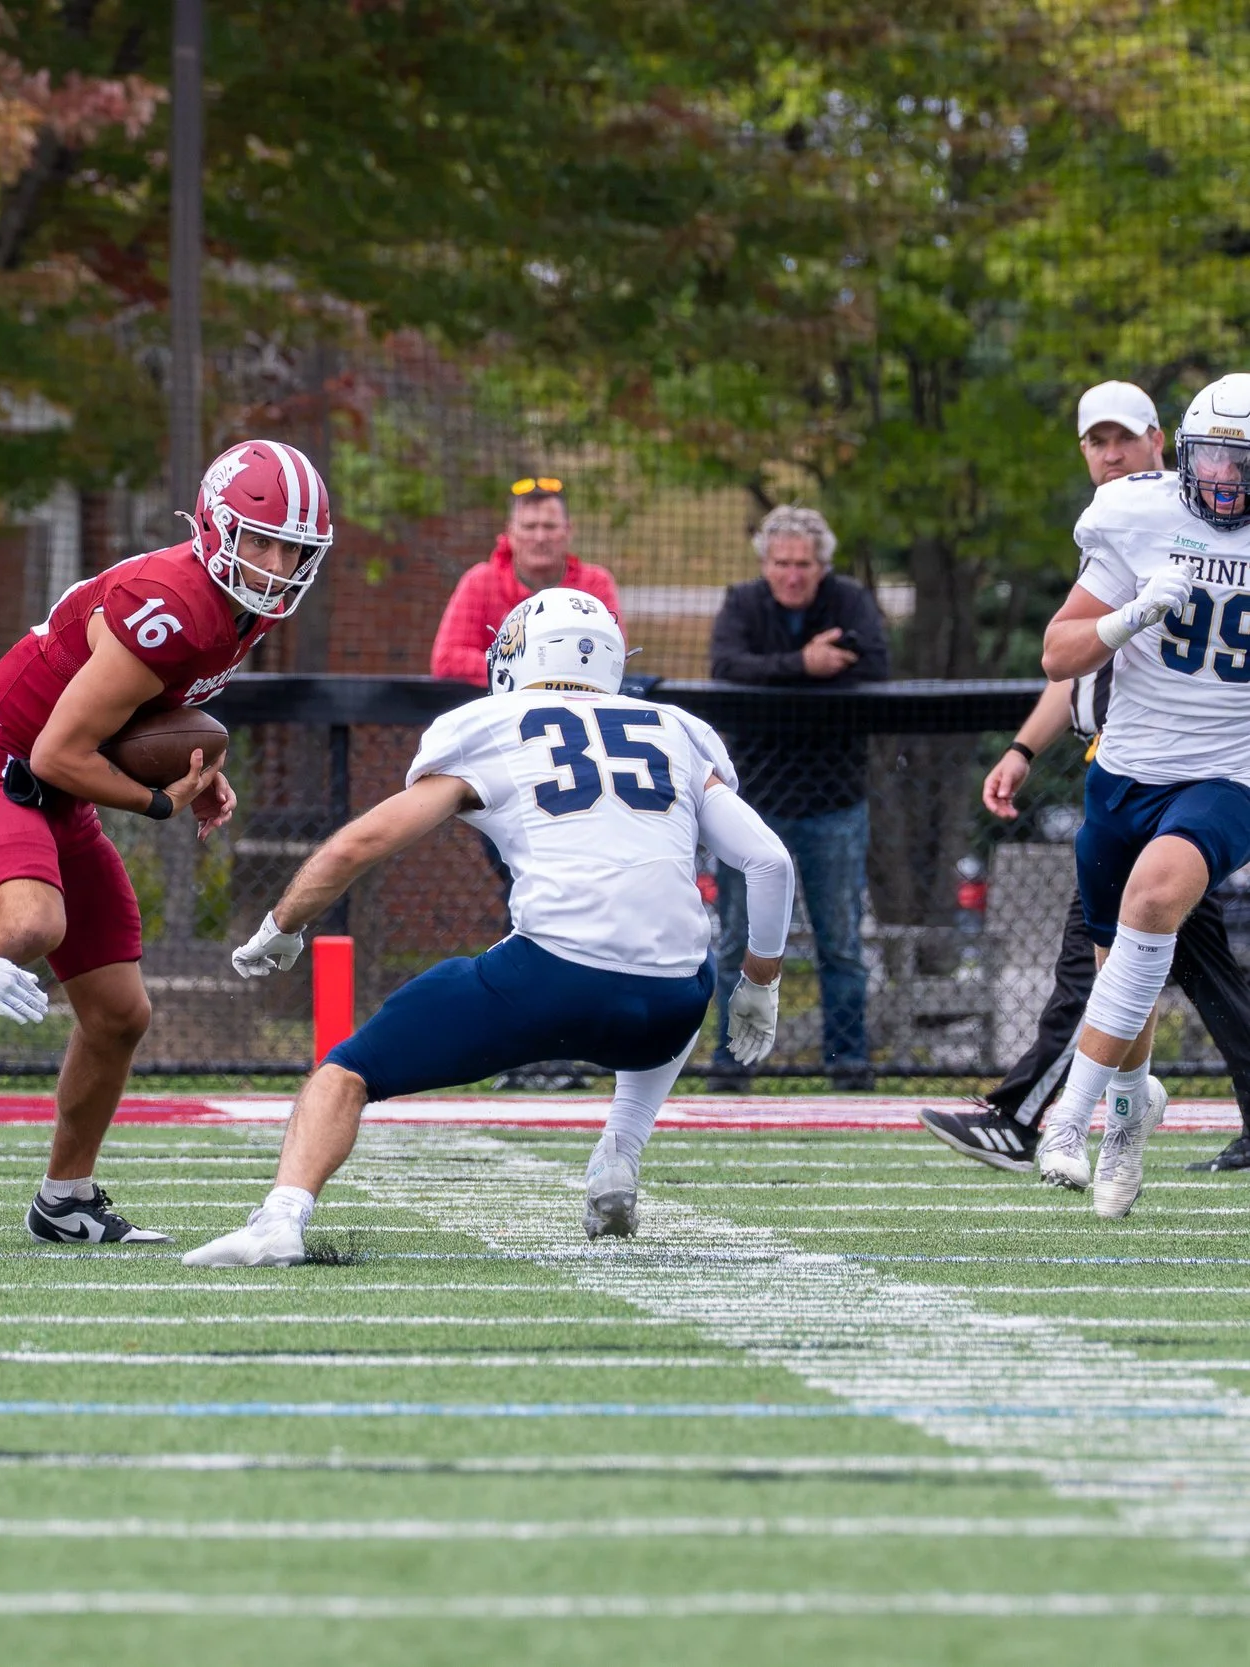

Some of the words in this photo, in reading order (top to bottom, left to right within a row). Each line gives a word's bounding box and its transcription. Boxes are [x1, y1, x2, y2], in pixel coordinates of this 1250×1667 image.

[123, 597, 183, 648] 16
[569, 597, 598, 614] 35
[1159, 584, 1250, 685] 99
[518, 706, 678, 819] 35
